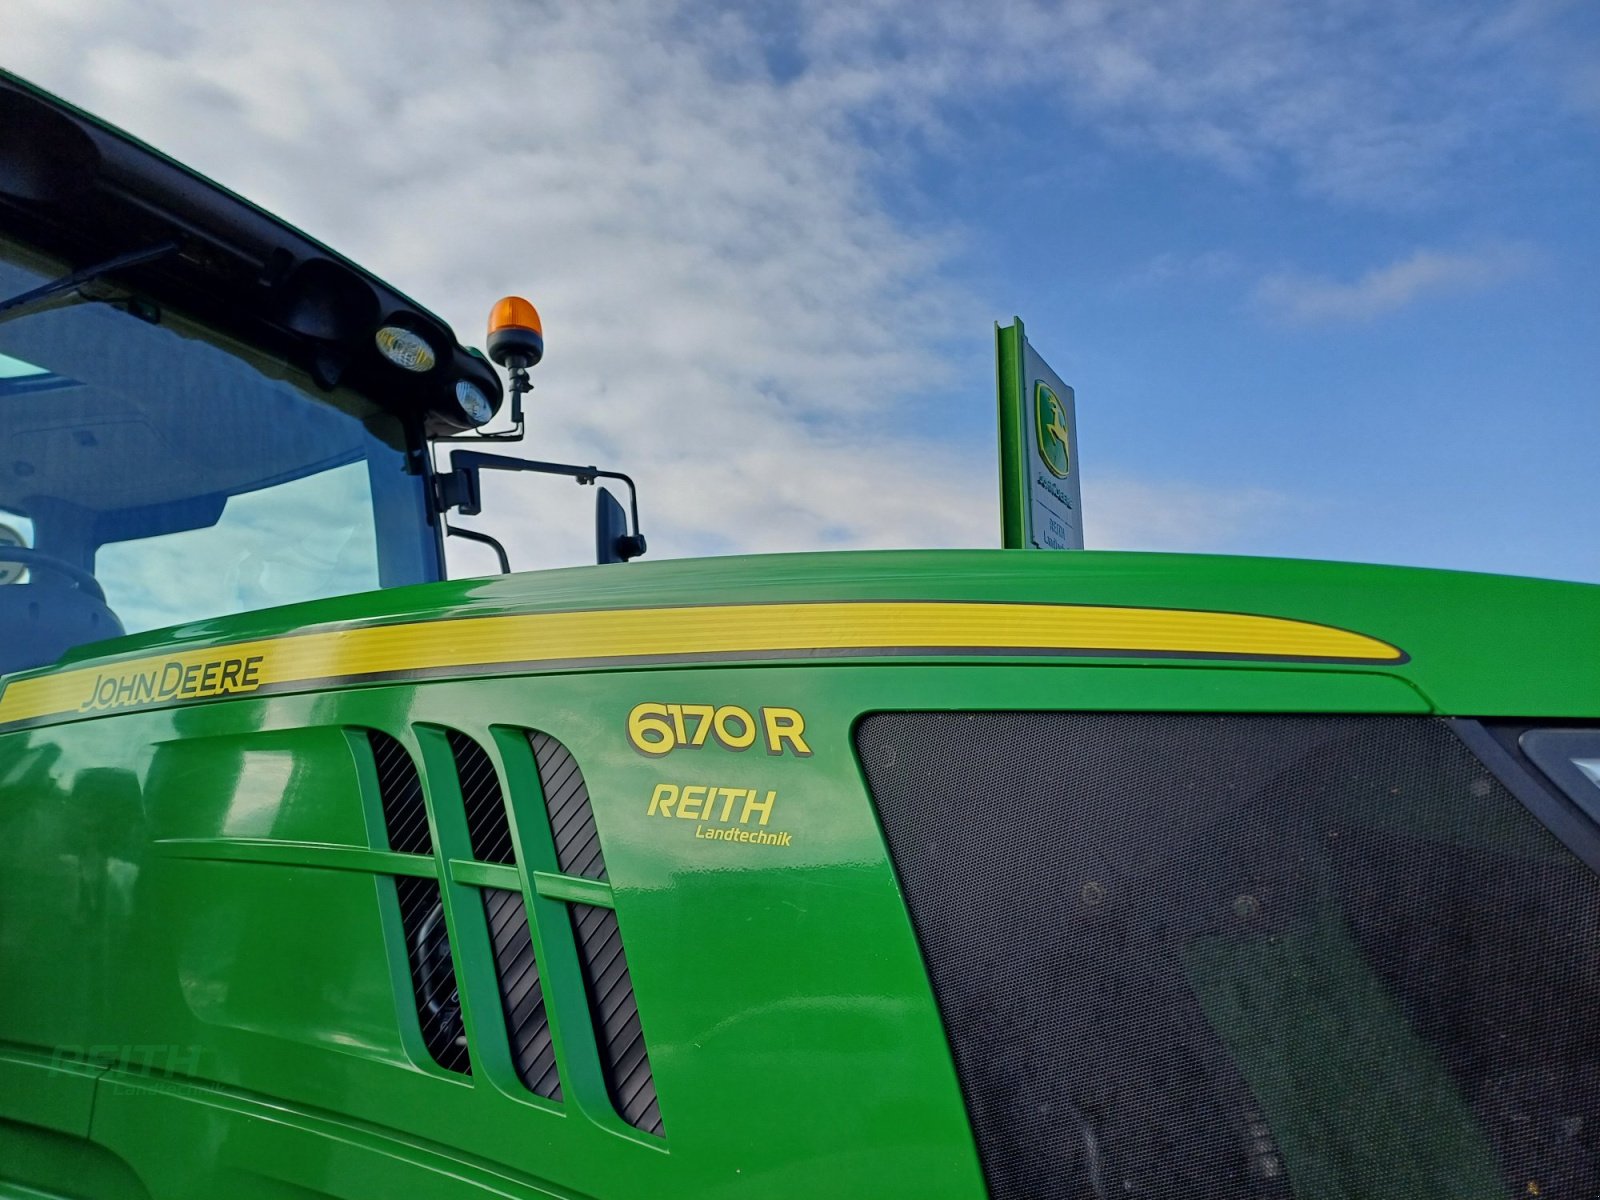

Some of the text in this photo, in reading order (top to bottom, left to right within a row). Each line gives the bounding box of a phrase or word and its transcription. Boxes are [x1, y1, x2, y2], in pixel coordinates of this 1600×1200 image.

[82, 655, 264, 707] JOHN DEERE
[646, 783, 777, 826] REITH
[695, 824, 793, 847] Landtechnik
